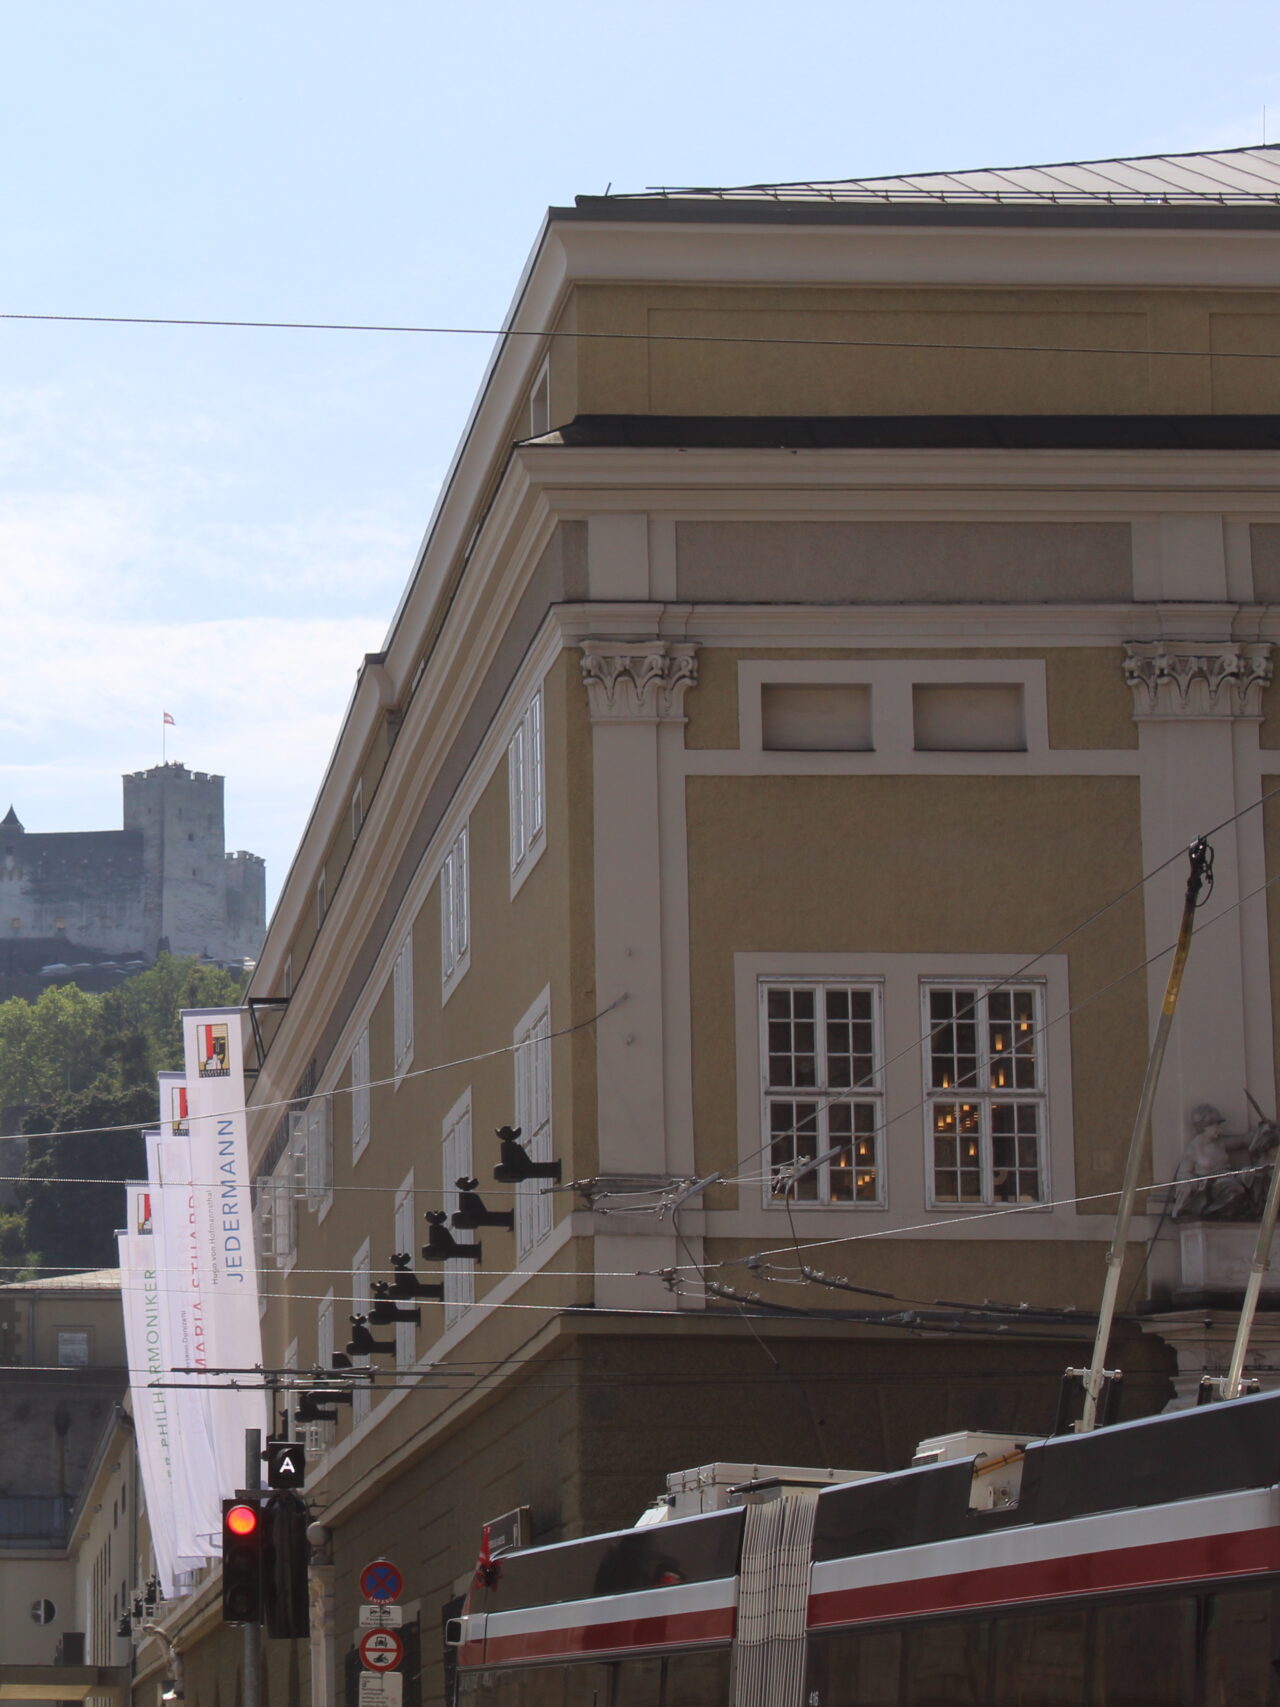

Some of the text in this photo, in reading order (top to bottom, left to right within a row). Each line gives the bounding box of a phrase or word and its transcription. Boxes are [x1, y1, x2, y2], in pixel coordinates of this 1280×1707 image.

[216, 1119, 244, 1283] JEDERMANN
[211, 1262, 219, 1285] Hugo
[144, 1268, 169, 1449] PHILHARMONIKER
[279, 1457, 296, 1473] A
